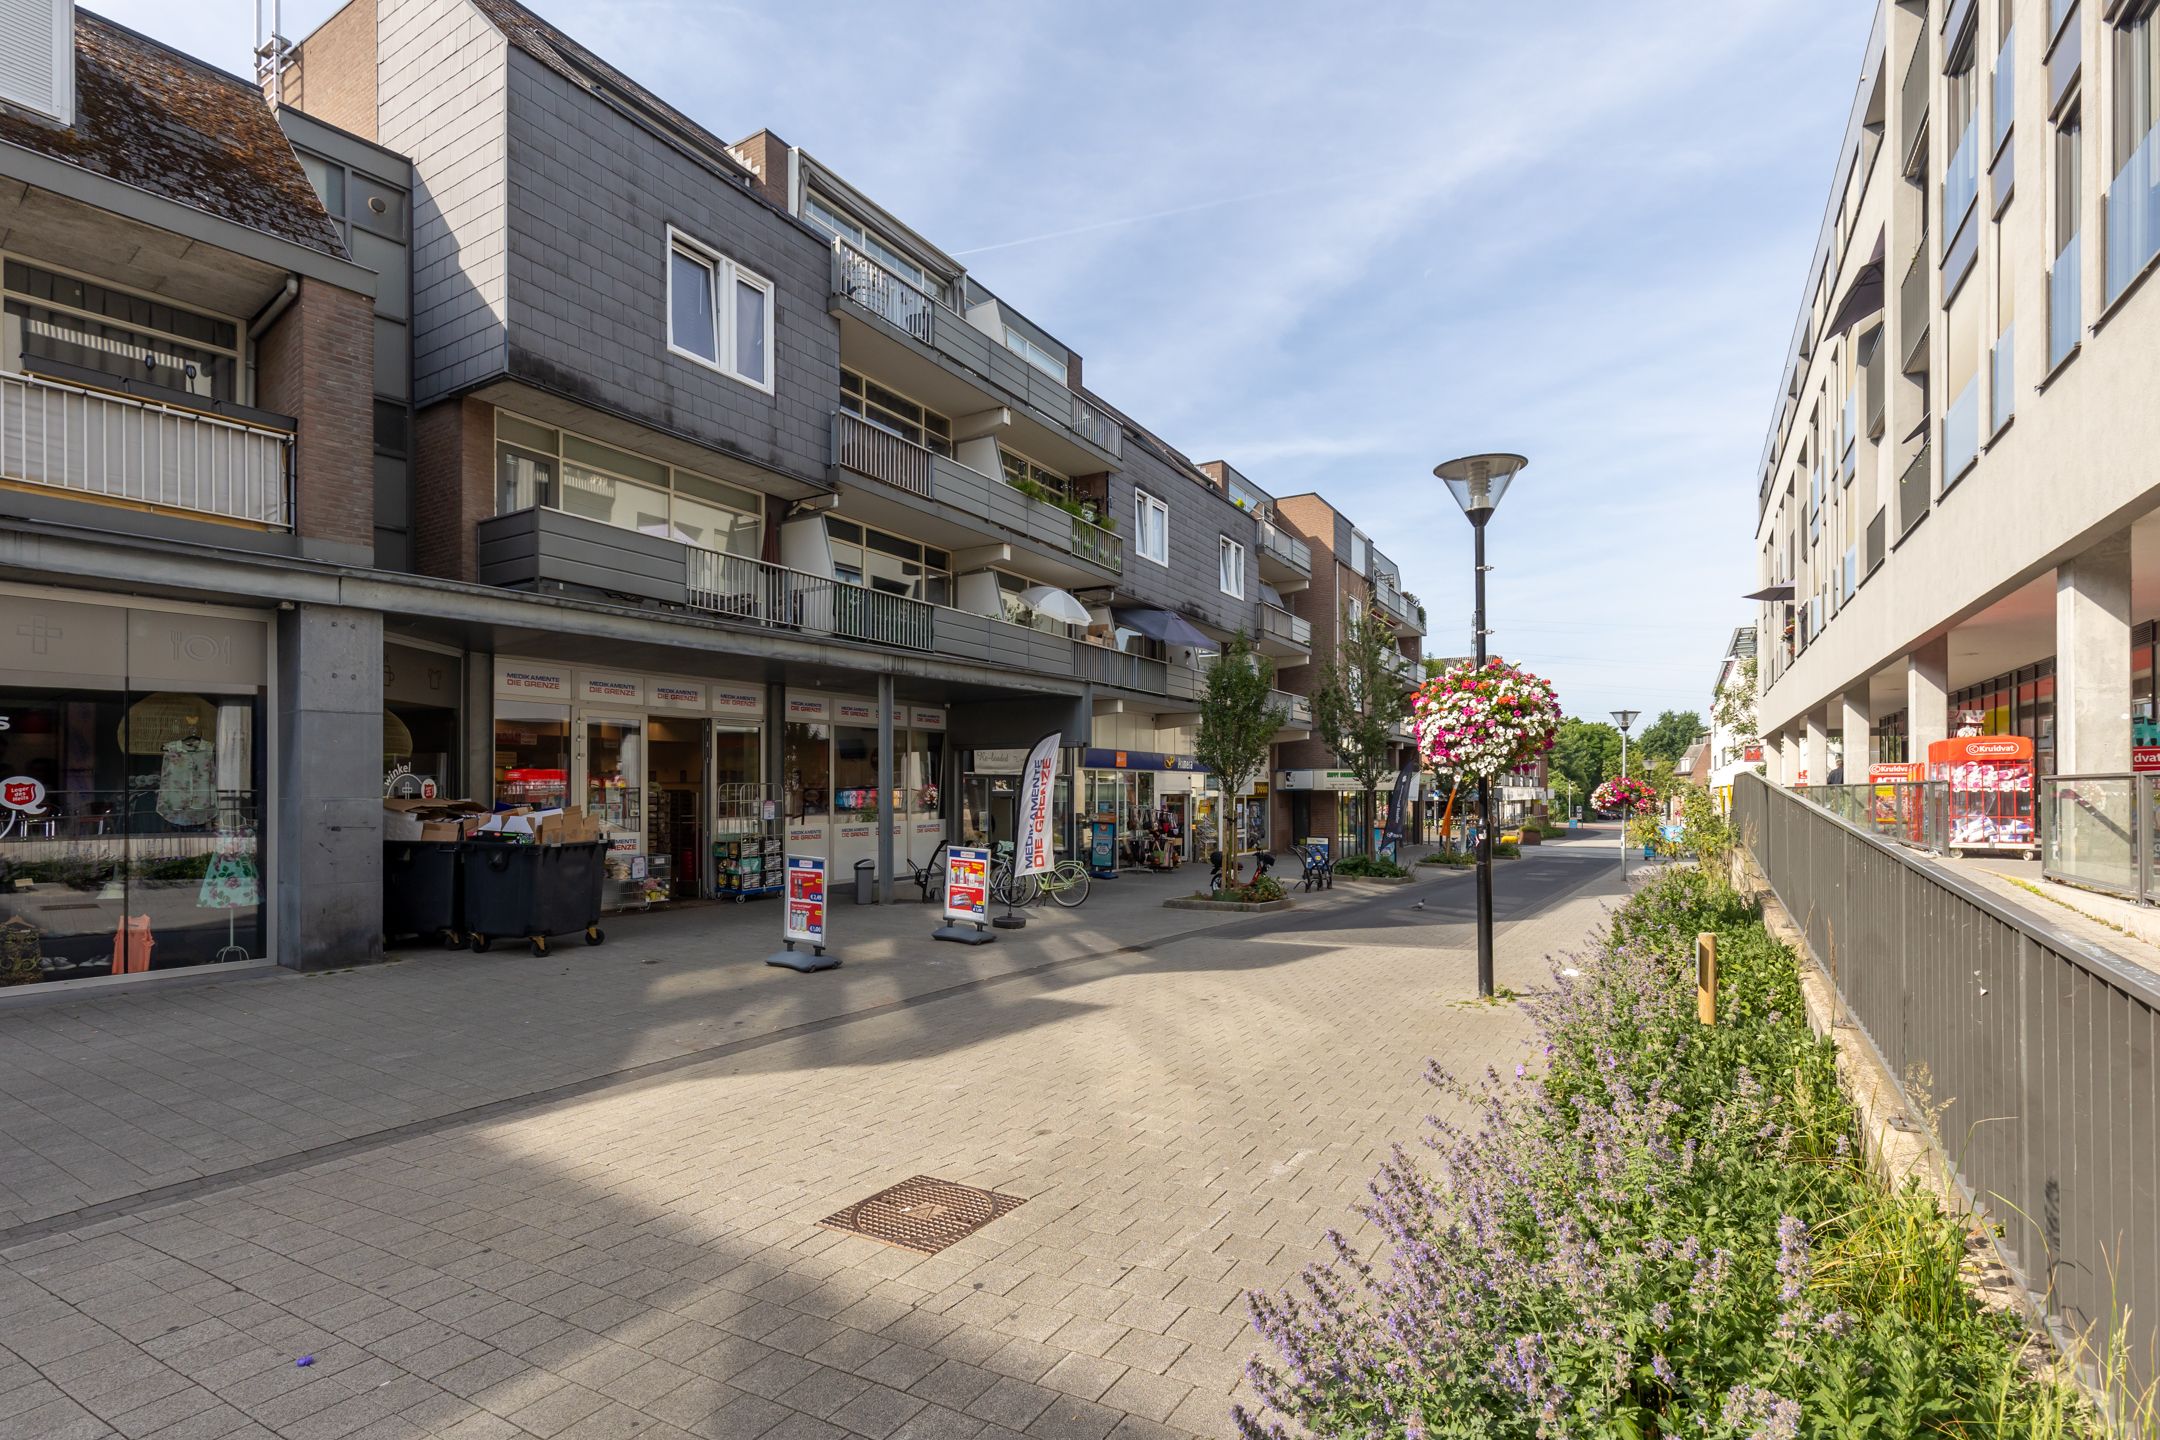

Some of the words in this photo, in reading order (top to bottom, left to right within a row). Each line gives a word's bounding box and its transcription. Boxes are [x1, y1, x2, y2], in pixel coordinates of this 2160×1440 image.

[507, 673, 560, 682] MEDIKAMENTE
[524, 681, 560, 689] GRENZE
[589, 681, 635, 690] MEDIKAMENTE
[604, 688, 635, 696] GRENZE
[1978, 744, 2015, 753] Kruidvat
[384, 762, 411, 786] winkel
[1035, 758, 1051, 832] GRENZE
[1025, 760, 1041, 869] MEDIKAMENTE
[1034, 838, 1044, 868] DIE
